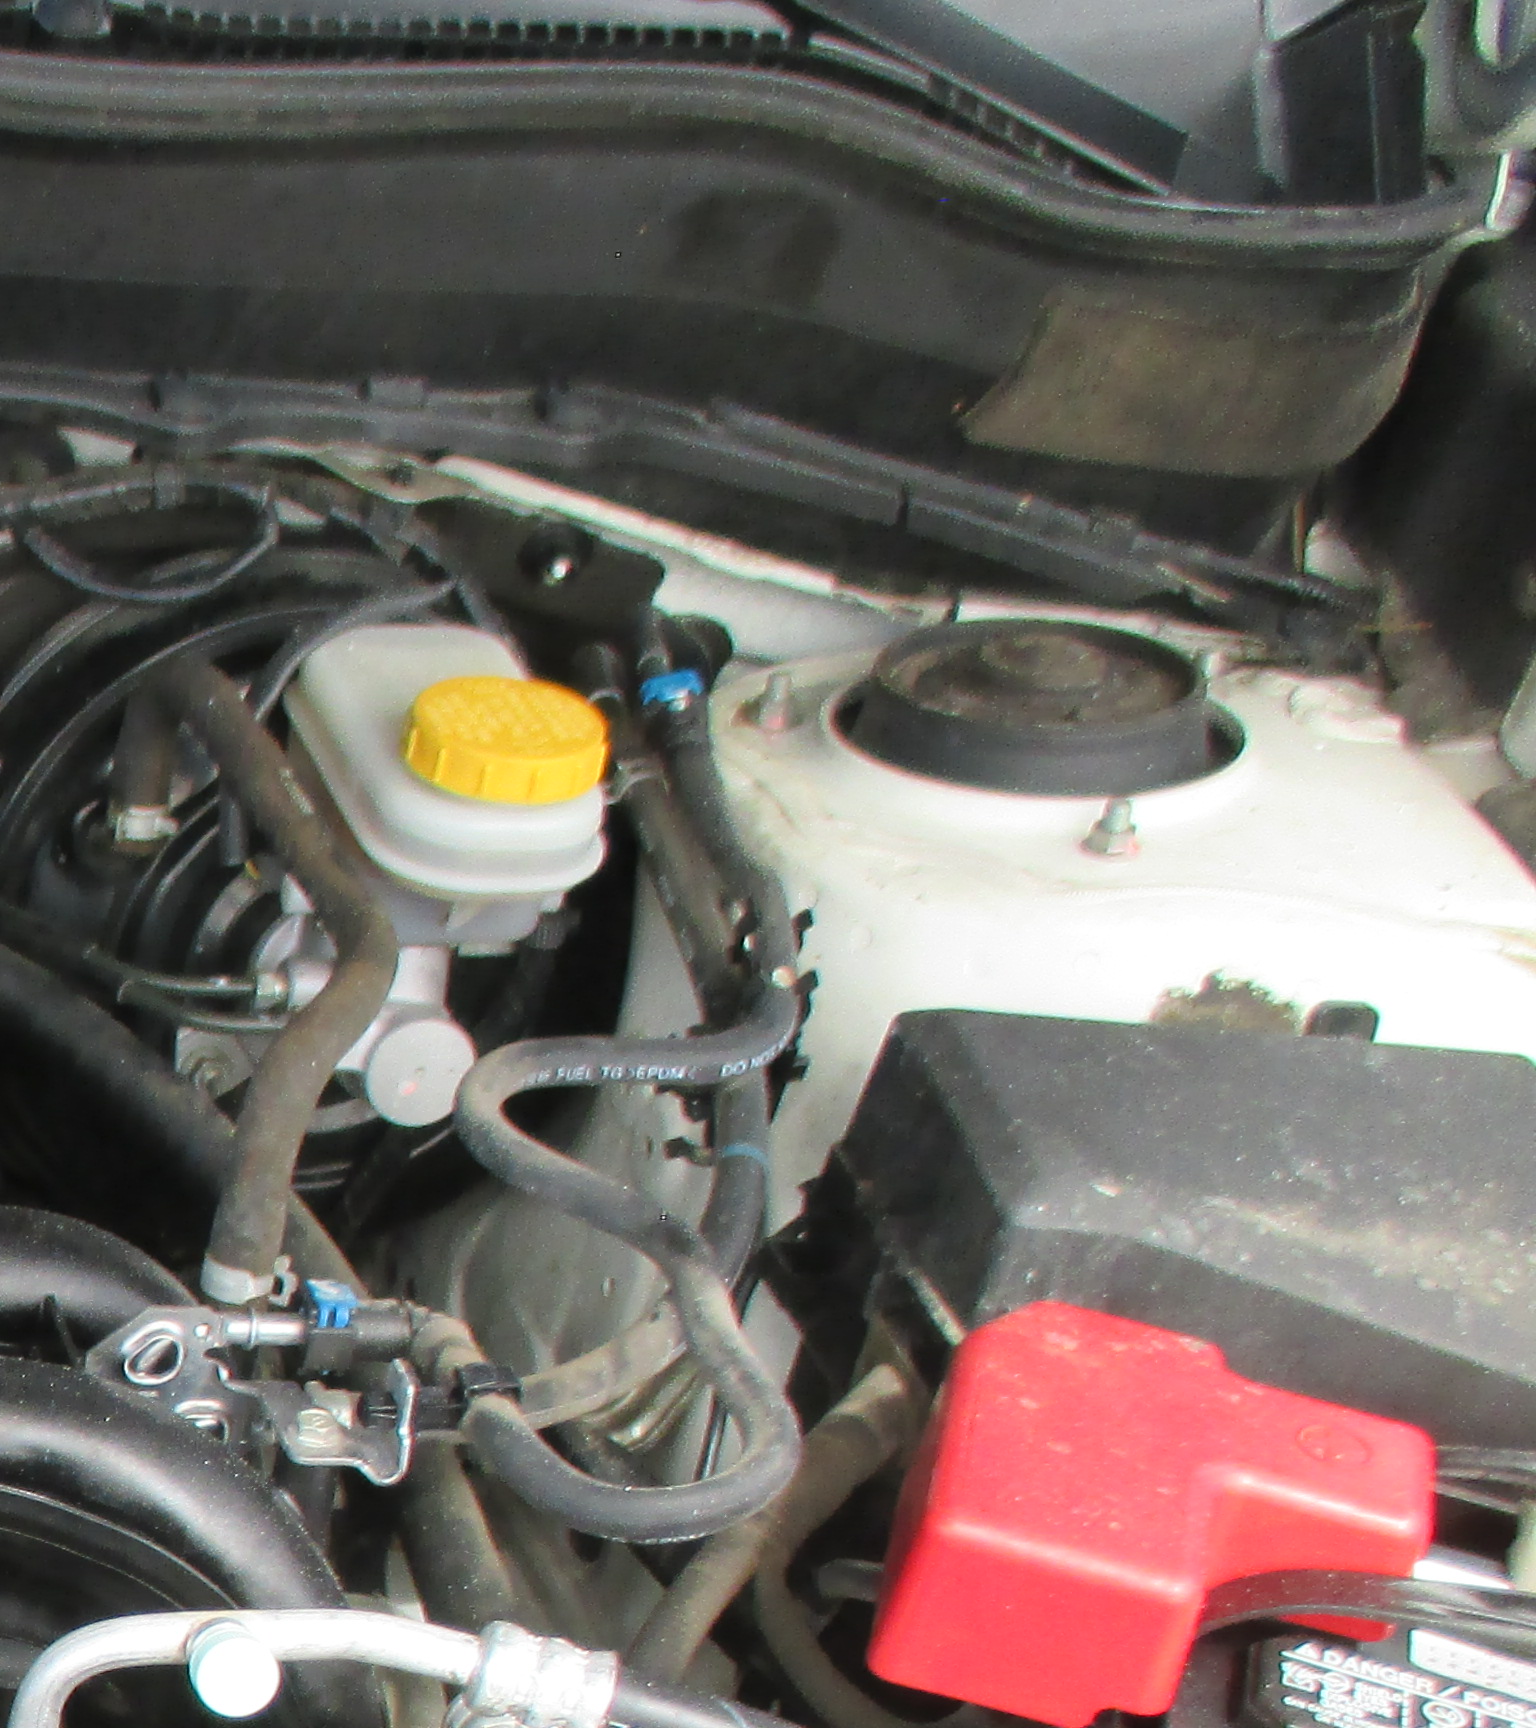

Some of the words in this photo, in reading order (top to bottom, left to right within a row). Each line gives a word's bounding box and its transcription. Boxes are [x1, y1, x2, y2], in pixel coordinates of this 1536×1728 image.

[555, 1066, 593, 1082] FUEL
[719, 1060, 746, 1078] DO
[1323, 1649, 1437, 1695] DANGER
